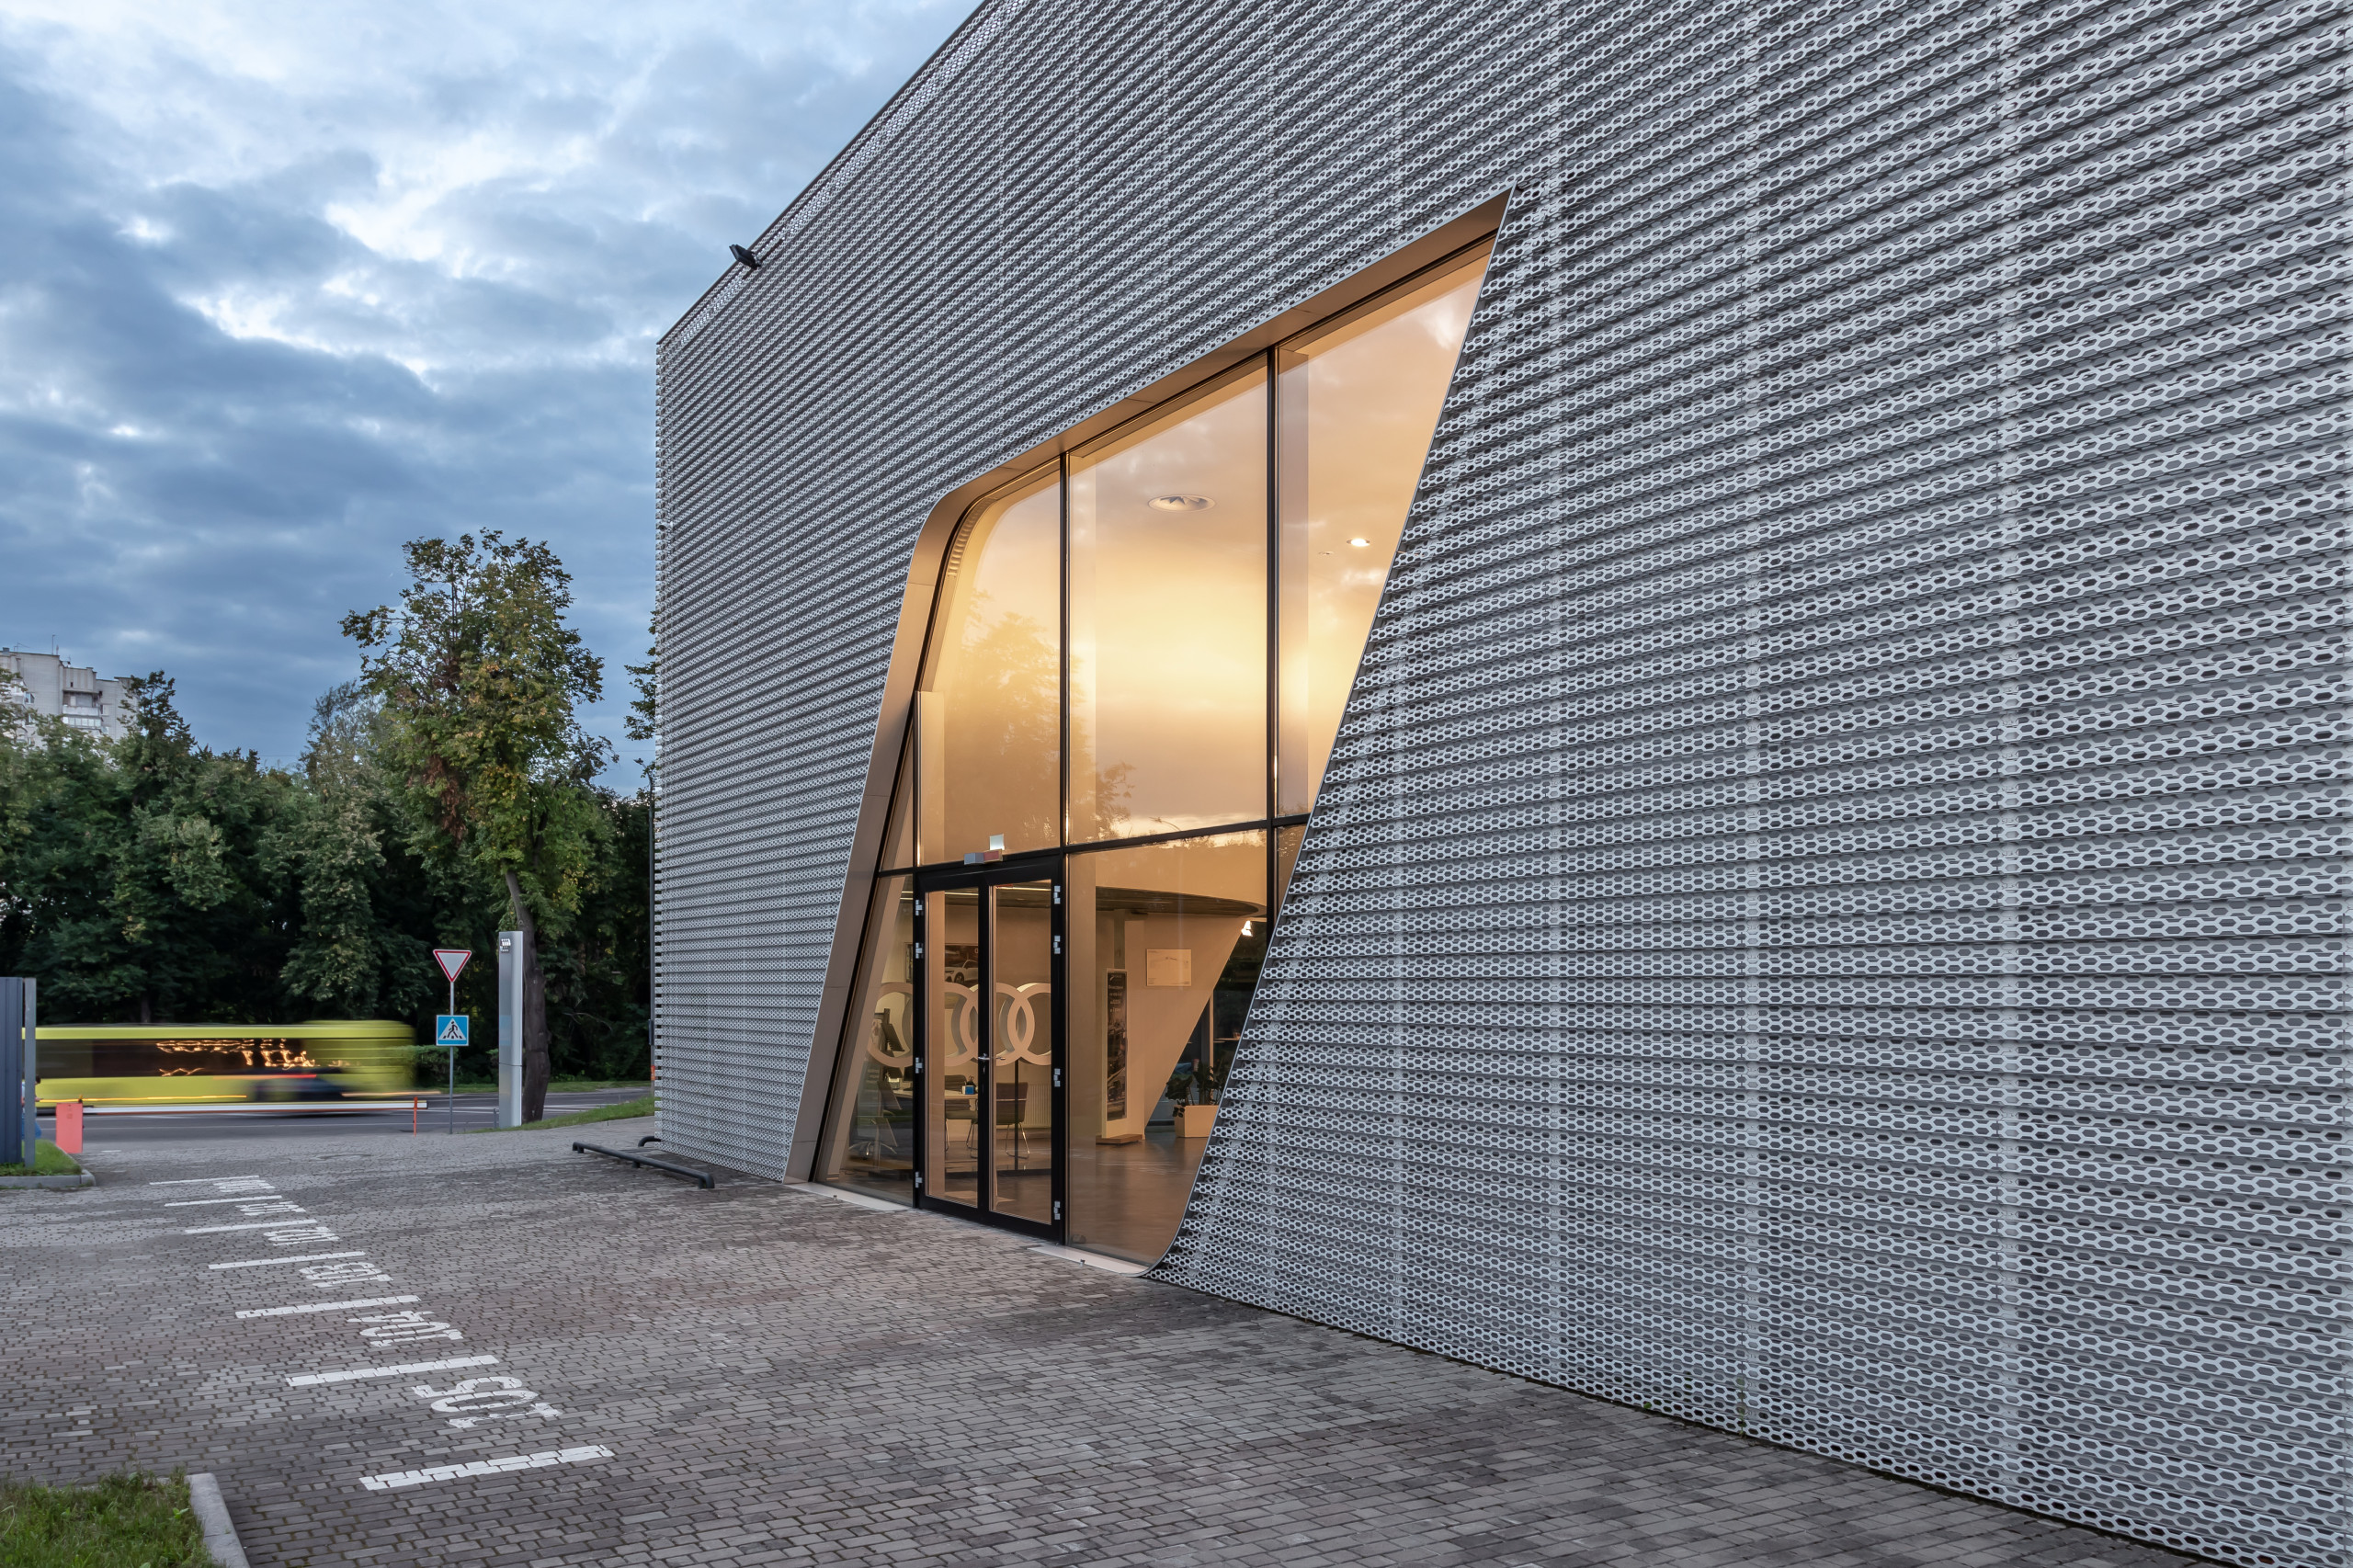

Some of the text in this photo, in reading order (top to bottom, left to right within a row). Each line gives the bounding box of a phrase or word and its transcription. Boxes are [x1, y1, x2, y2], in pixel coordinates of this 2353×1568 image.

[235, 1200, 306, 1216] 101
[263, 1226, 340, 1245] 102
[299, 1261, 393, 1287] 103
[347, 1310, 464, 1347] 104
[411, 1376, 563, 1428] 105
